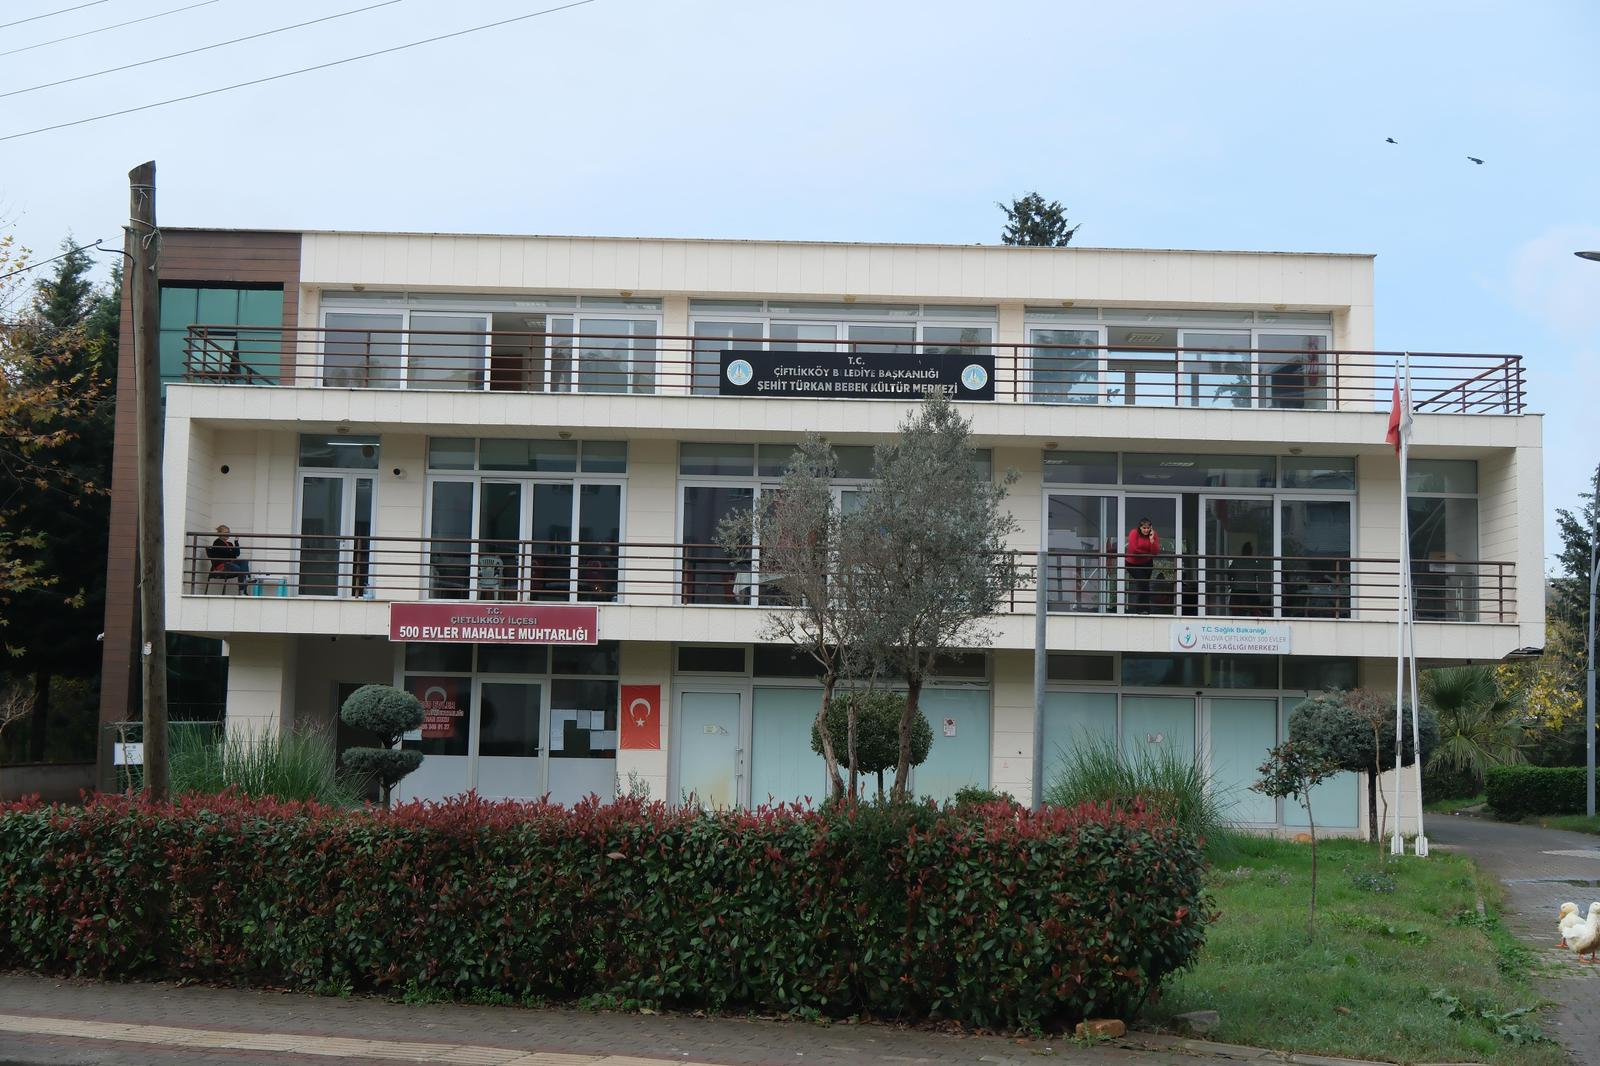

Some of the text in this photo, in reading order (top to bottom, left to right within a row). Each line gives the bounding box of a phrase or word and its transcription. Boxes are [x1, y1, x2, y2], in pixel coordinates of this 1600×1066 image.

[848, 356, 865, 365] T.C.
[773, 365, 830, 377] ÇİFTLİKKÖY
[878, 368, 939, 380] BAŞKANLIĞI
[757, 379, 958, 394] ŞEHİT TÜRKAN BEBEK KÜLTÜR MERKEZİ
[486, 607, 503, 615] T.C.
[508, 616, 537, 626] İLÇESİ
[399, 626, 588, 641] 500 EVLER MAHALLE MUHTARLIĞI
[1214, 626, 1235, 634] Sağlık
[1236, 627, 1266, 635] Bakanlığı
[1247, 643, 1279, 652] MERKEZİ
